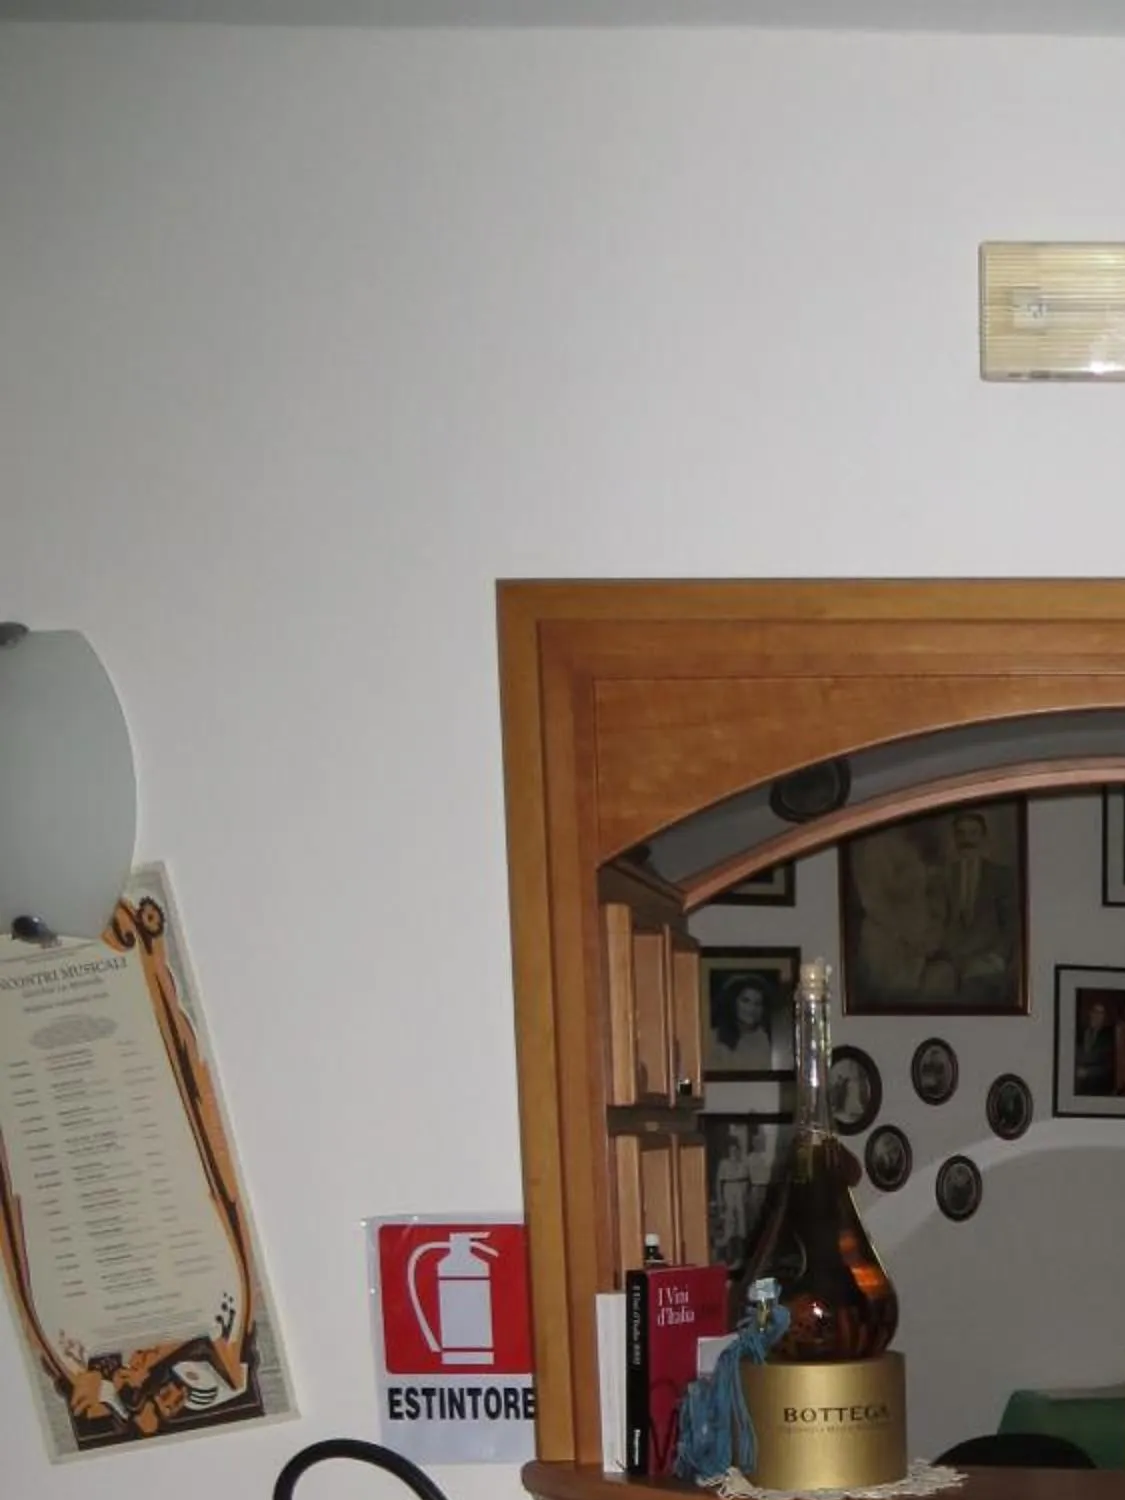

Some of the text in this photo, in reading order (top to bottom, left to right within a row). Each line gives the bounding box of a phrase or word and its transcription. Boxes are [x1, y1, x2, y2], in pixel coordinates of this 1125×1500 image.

[665, 1283, 690, 1305] Vini
[657, 1305, 696, 1327] d'Italia
[387, 1386, 537, 1421] ESTINTORE
[783, 1404, 890, 1422] BOTTEGA
